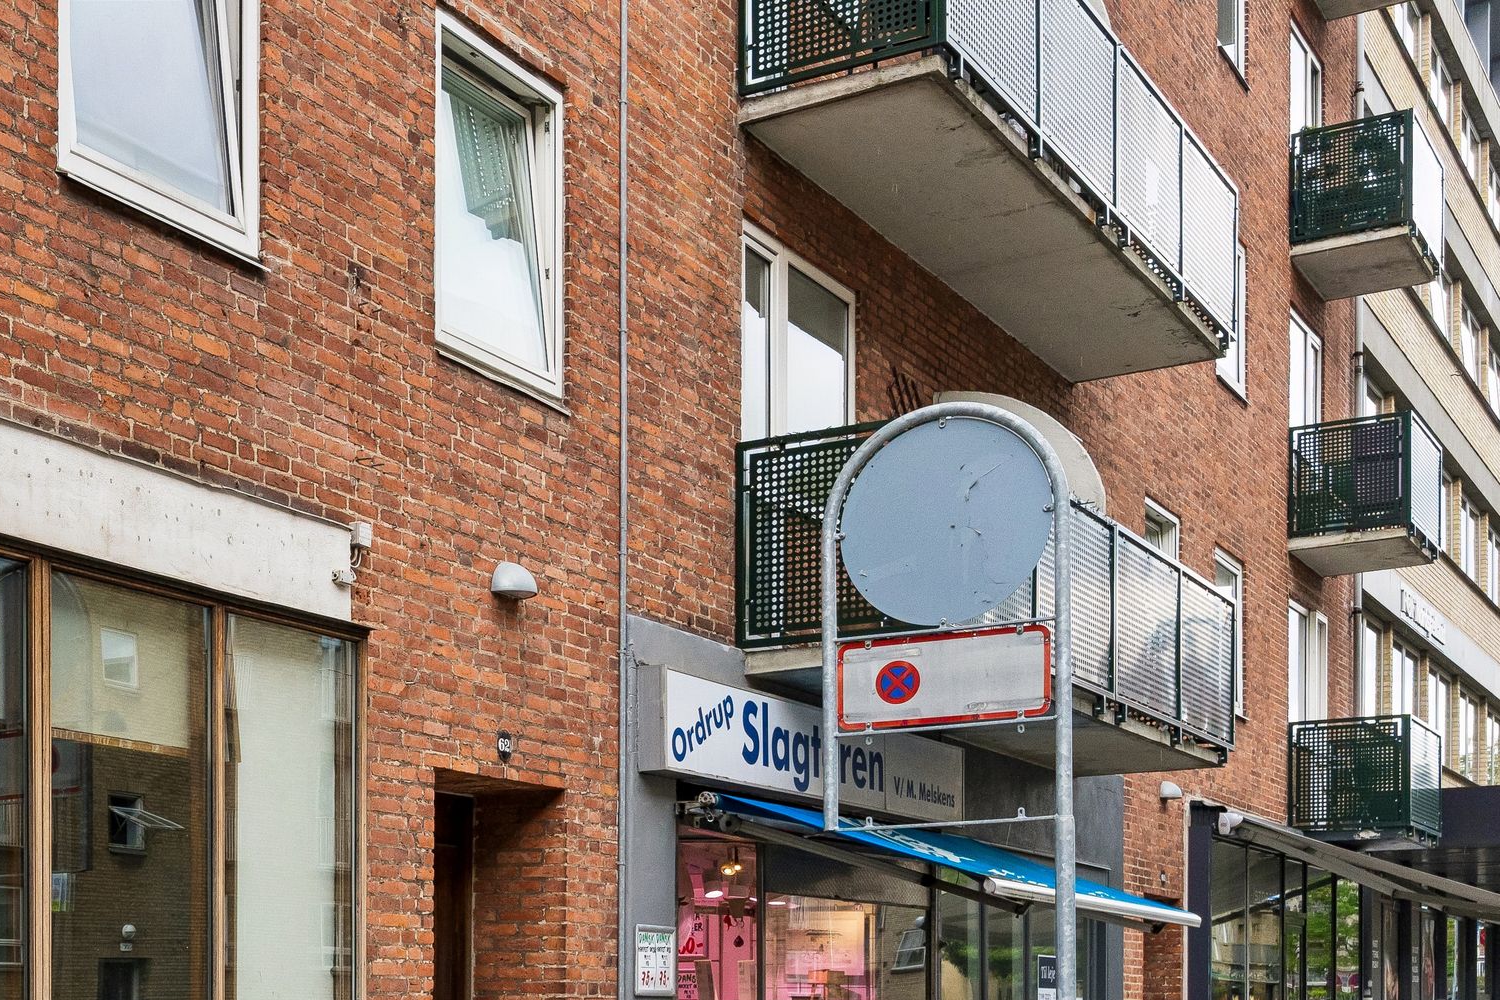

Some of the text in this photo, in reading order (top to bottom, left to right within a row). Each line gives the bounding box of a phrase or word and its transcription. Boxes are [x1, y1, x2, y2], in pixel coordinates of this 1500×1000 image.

[498, 738, 511, 752] 62
[672, 694, 735, 763] Ordrup
[742, 700, 884, 792] Slagtren
[906, 782, 917, 800] M.
[918, 783, 956, 807] Melskens
